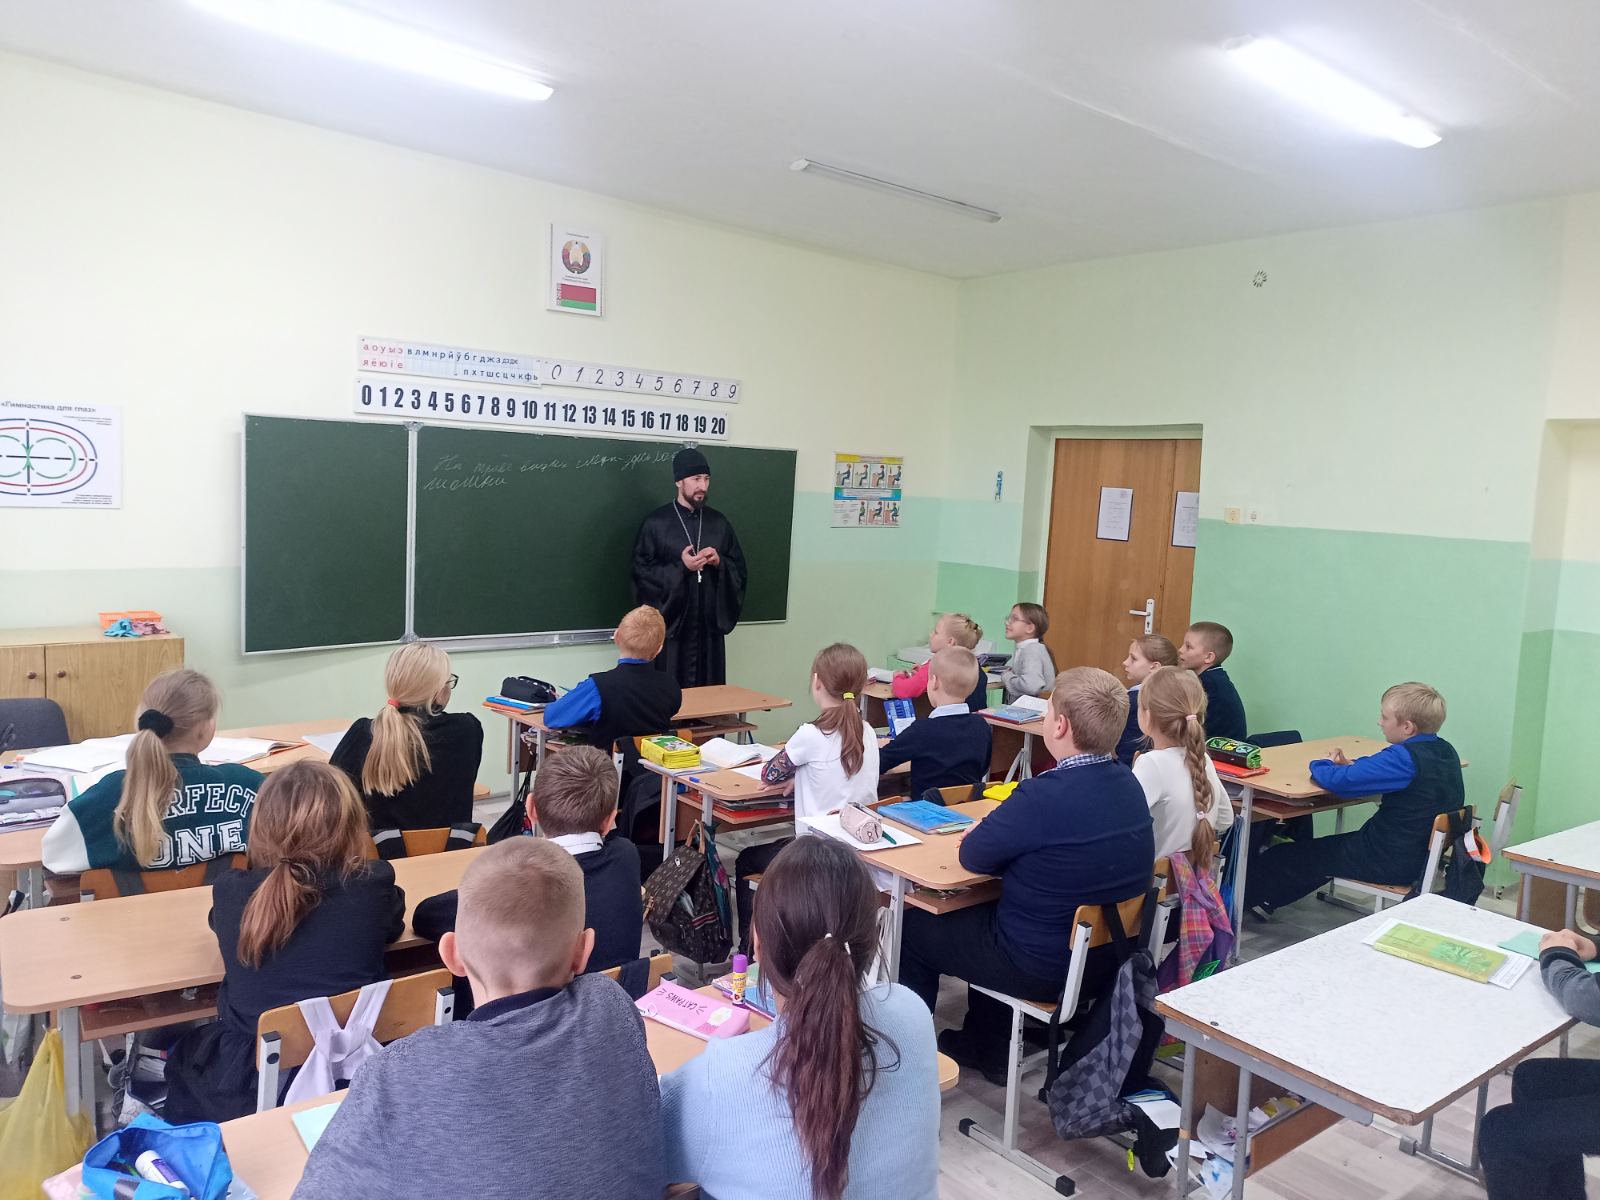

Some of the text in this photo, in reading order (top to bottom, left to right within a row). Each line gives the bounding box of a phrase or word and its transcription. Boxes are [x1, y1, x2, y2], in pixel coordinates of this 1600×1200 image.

[551, 364, 737, 399] 0 1 2 3 4 5 6 7 8 9
[361, 384, 726, 435] 0 1 2 3 4 5 6 7 8 9 10 11 12 13 14 15 16 17 18 19 20
[162, 783, 257, 820] RFECT
